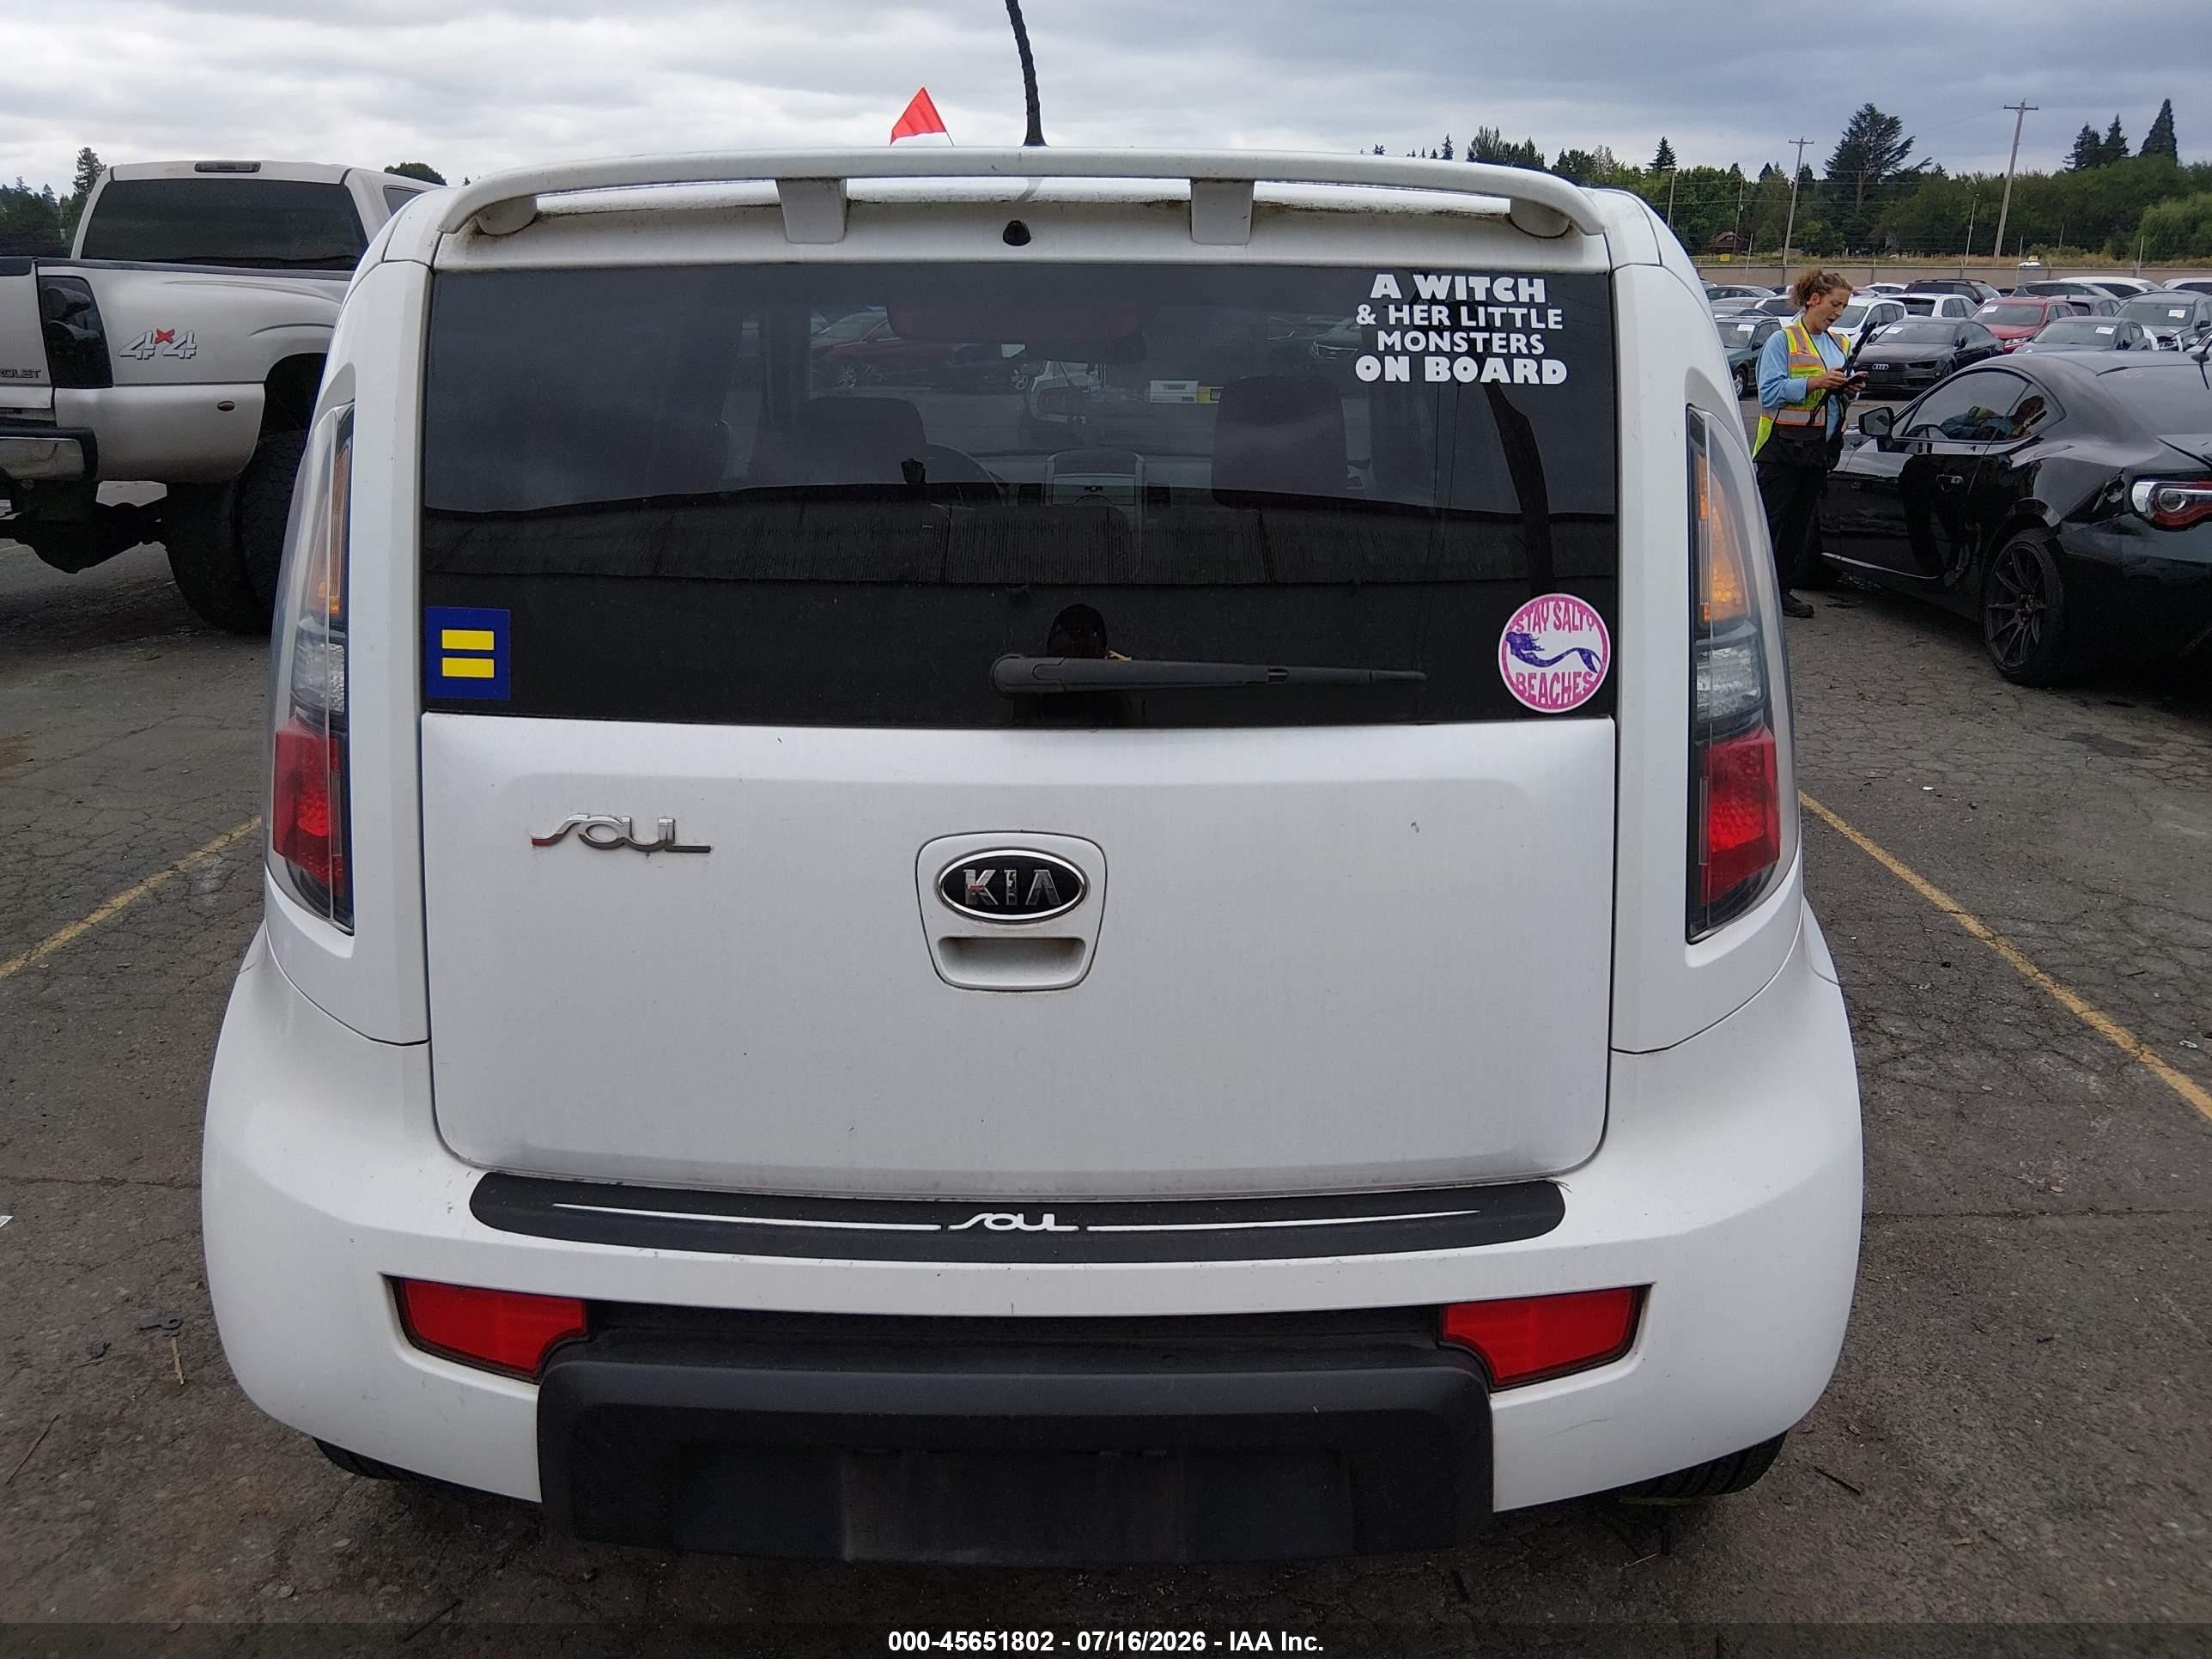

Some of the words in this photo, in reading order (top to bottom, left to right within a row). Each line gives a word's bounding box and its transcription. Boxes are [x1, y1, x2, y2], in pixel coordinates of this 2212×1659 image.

[1370, 274, 1402, 299] A
[1413, 275, 1546, 303] WITCH
[1356, 304, 1376, 325] &
[1388, 304, 1451, 326] HER
[1460, 306, 1564, 330] LITTLE
[1377, 331, 1545, 355] MONSTERS
[1355, 355, 1410, 382] ON
[1425, 356, 1568, 385] BOARD
[1515, 602, 1550, 634] STAY
[1553, 601, 1595, 633] SALTY
[1516, 672, 1596, 705] BEACHES
[963, 869, 1064, 906] KIA
